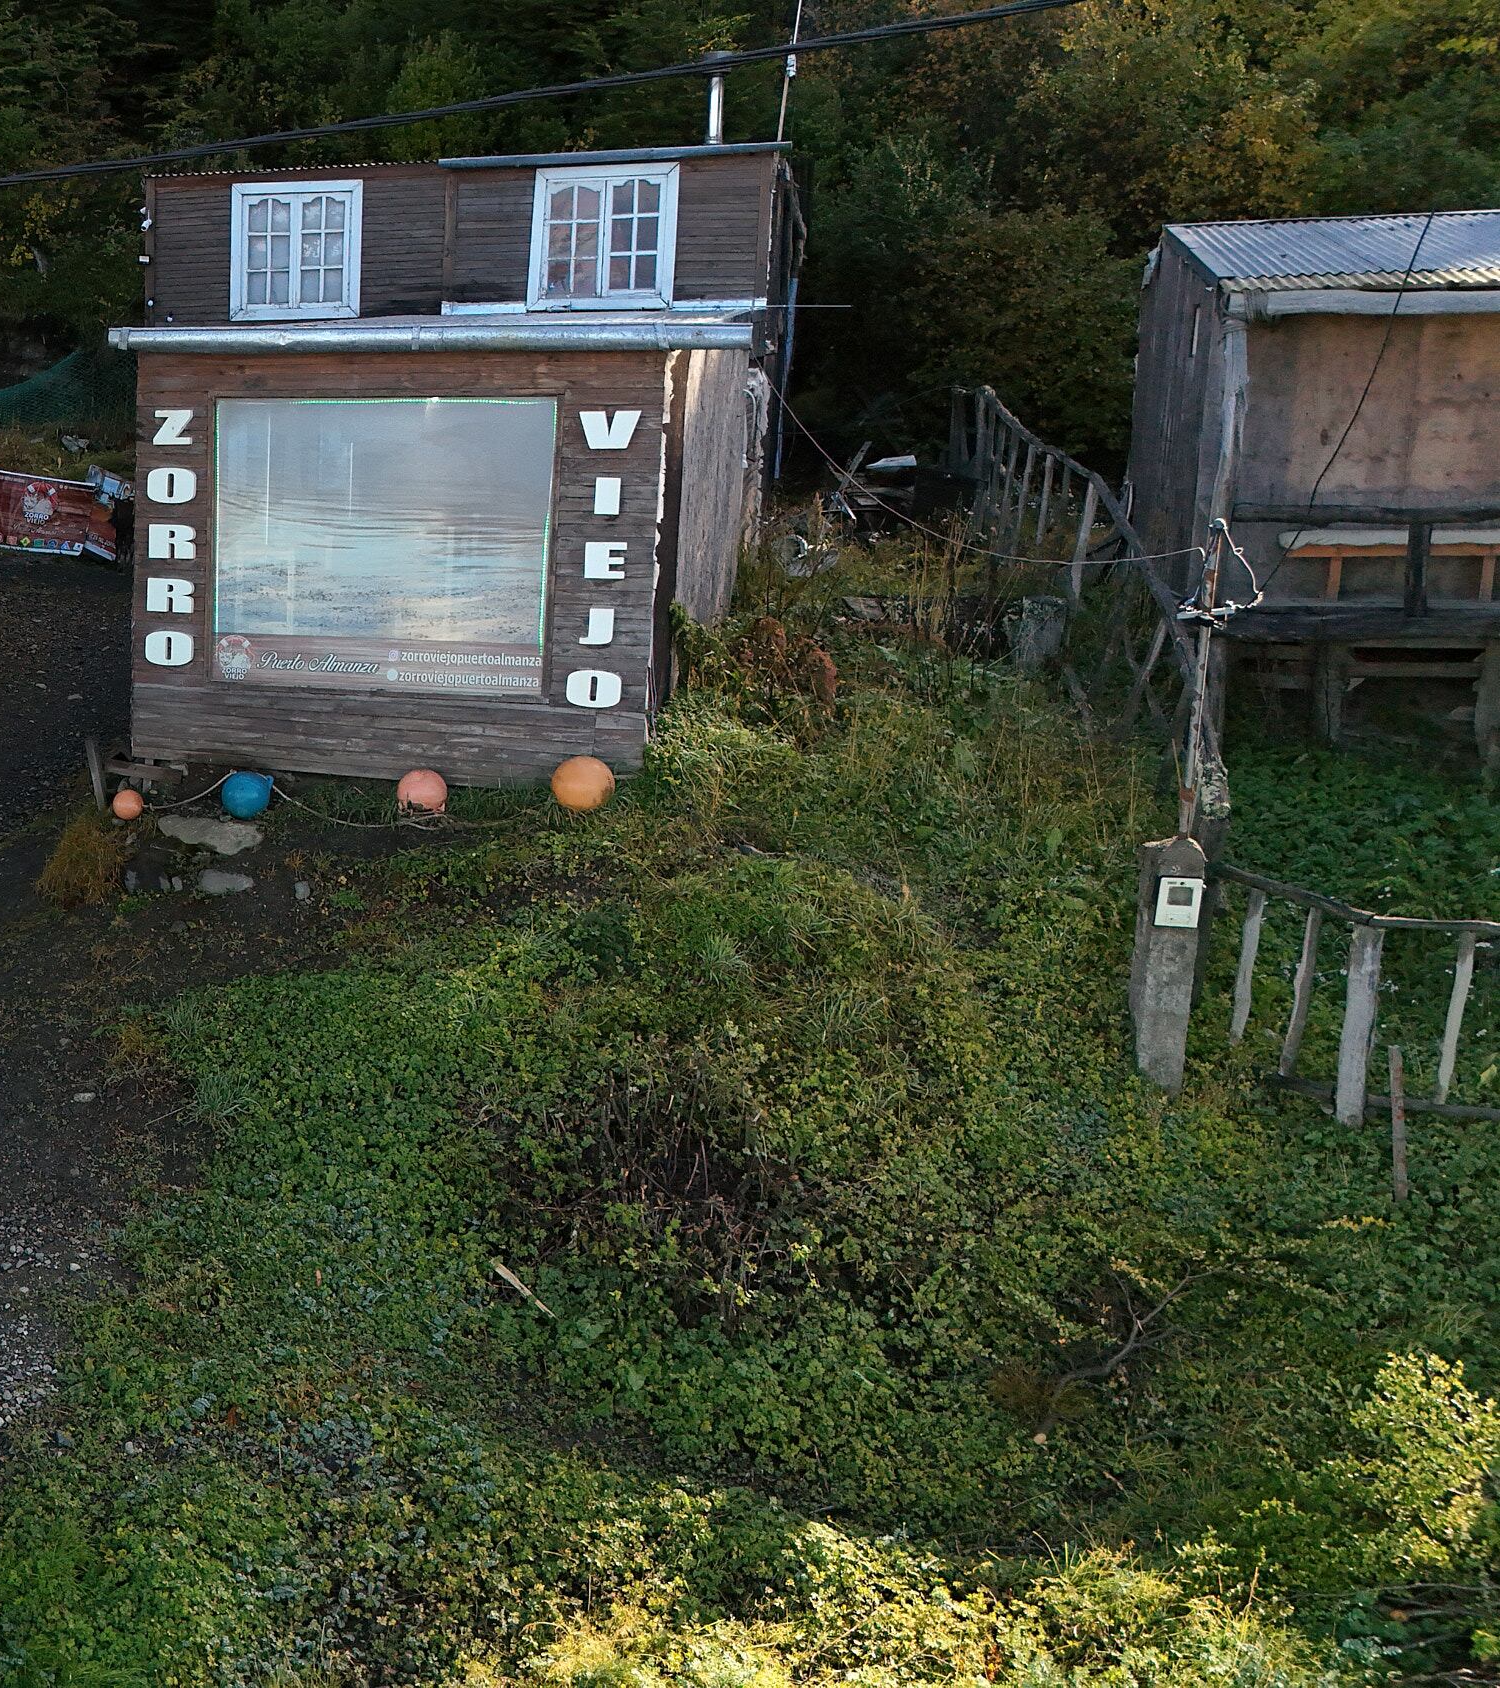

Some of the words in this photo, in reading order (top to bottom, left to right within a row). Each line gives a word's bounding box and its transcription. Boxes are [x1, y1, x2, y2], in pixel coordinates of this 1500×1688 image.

[144, 409, 197, 668] ZORRO
[565, 410, 642, 709] VIEJO
[256, 651, 305, 670] Puerto
[308, 653, 379, 674] Almanza
[401, 651, 542, 667] zorroviejopuertoalmanza
[399, 671, 539, 688] zorroviejopuertoalmanza
